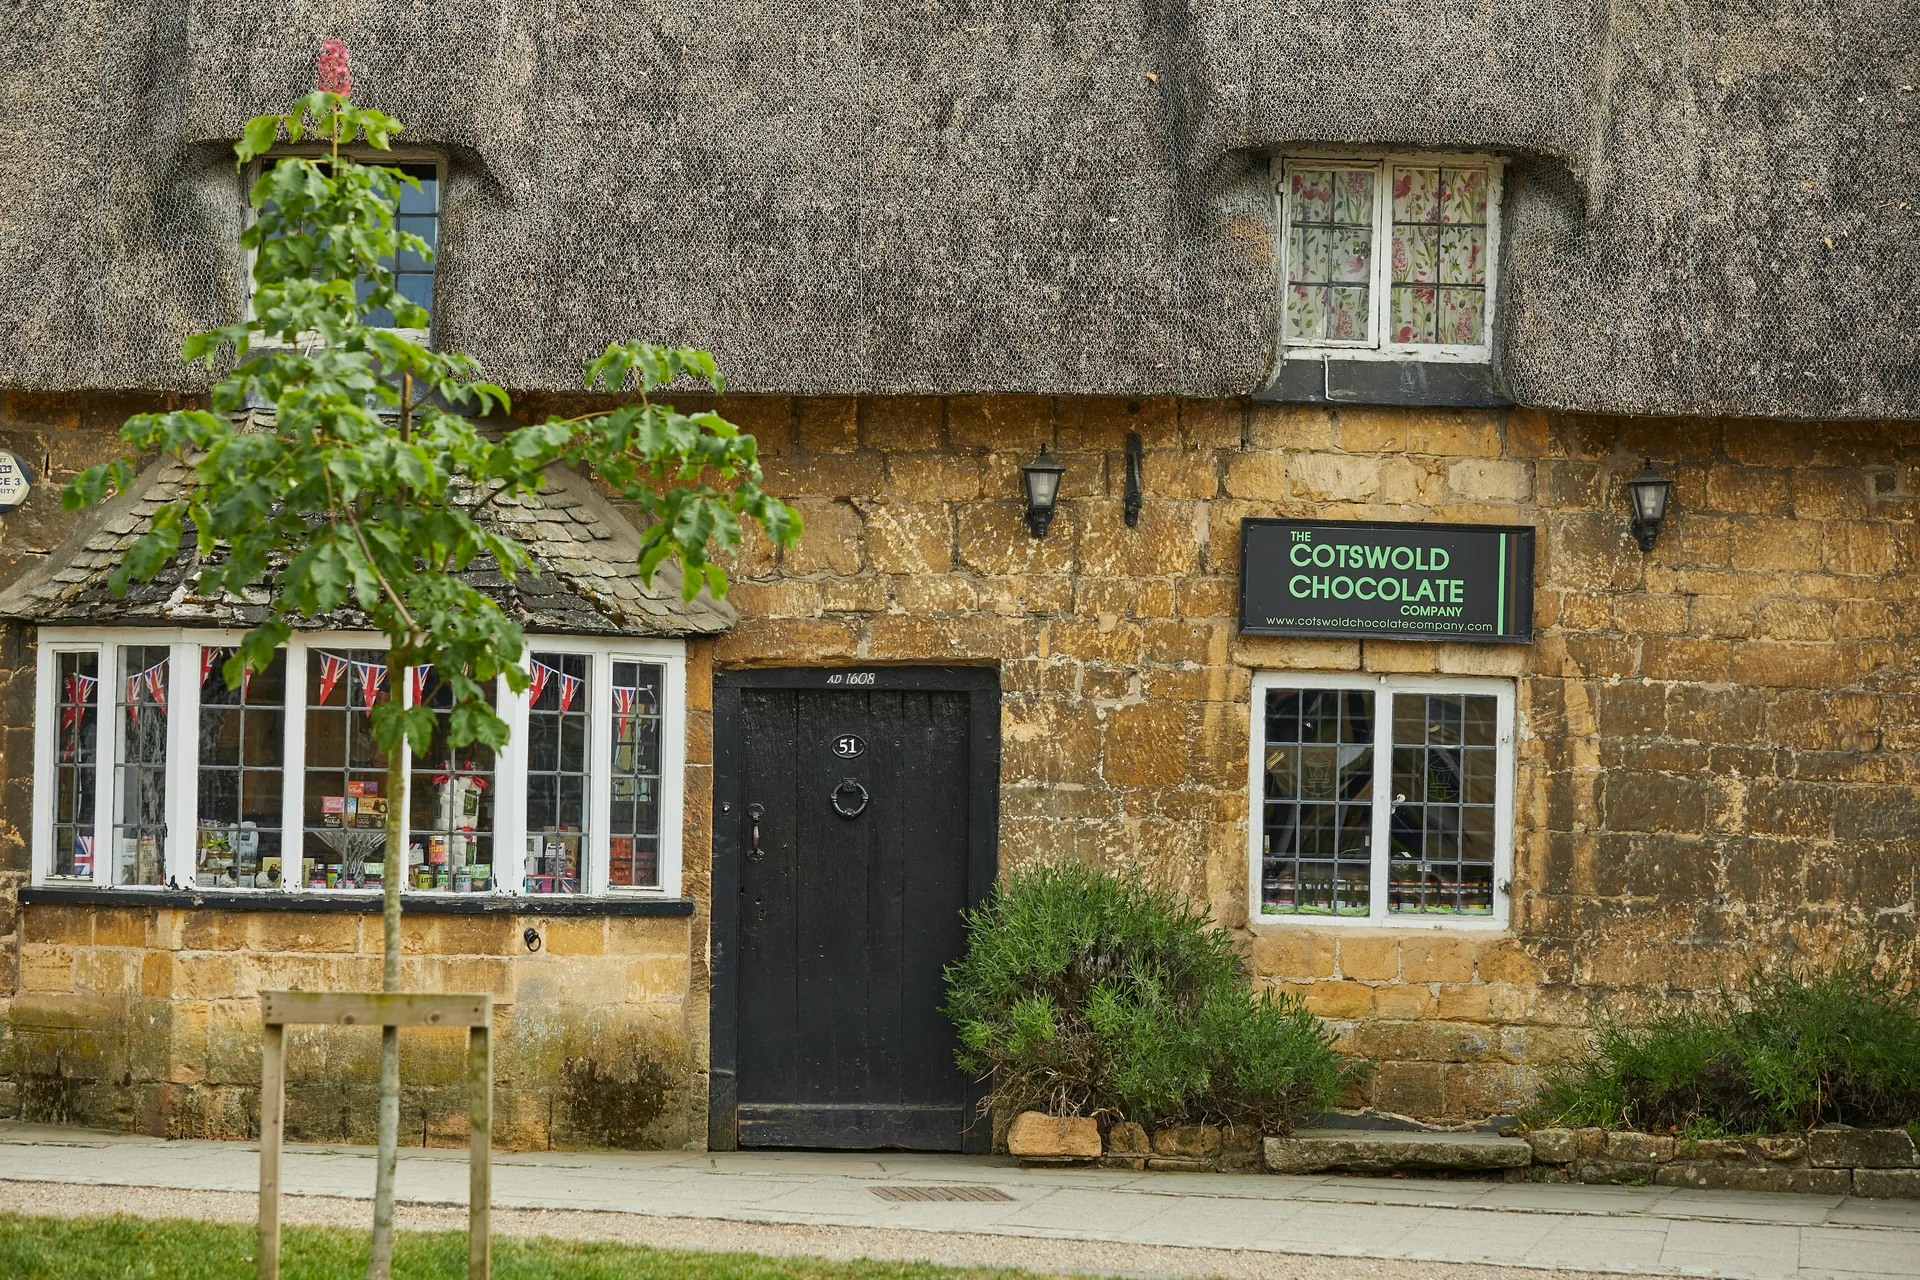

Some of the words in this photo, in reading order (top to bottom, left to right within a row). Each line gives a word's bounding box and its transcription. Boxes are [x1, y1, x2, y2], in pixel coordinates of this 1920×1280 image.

[1290, 531, 1312, 542] THE
[1289, 543, 1450, 571] COTSWOLD
[1288, 574, 1464, 603] CHOCOLATE
[1400, 605, 1463, 617] COMPANY
[1266, 616, 1493, 632] www.cotswoldchocolatecompany.com
[827, 674, 842, 684] AD
[846, 672, 876, 685] 1608
[838, 738, 857, 754] 51
[471, 864, 489, 877] egan
